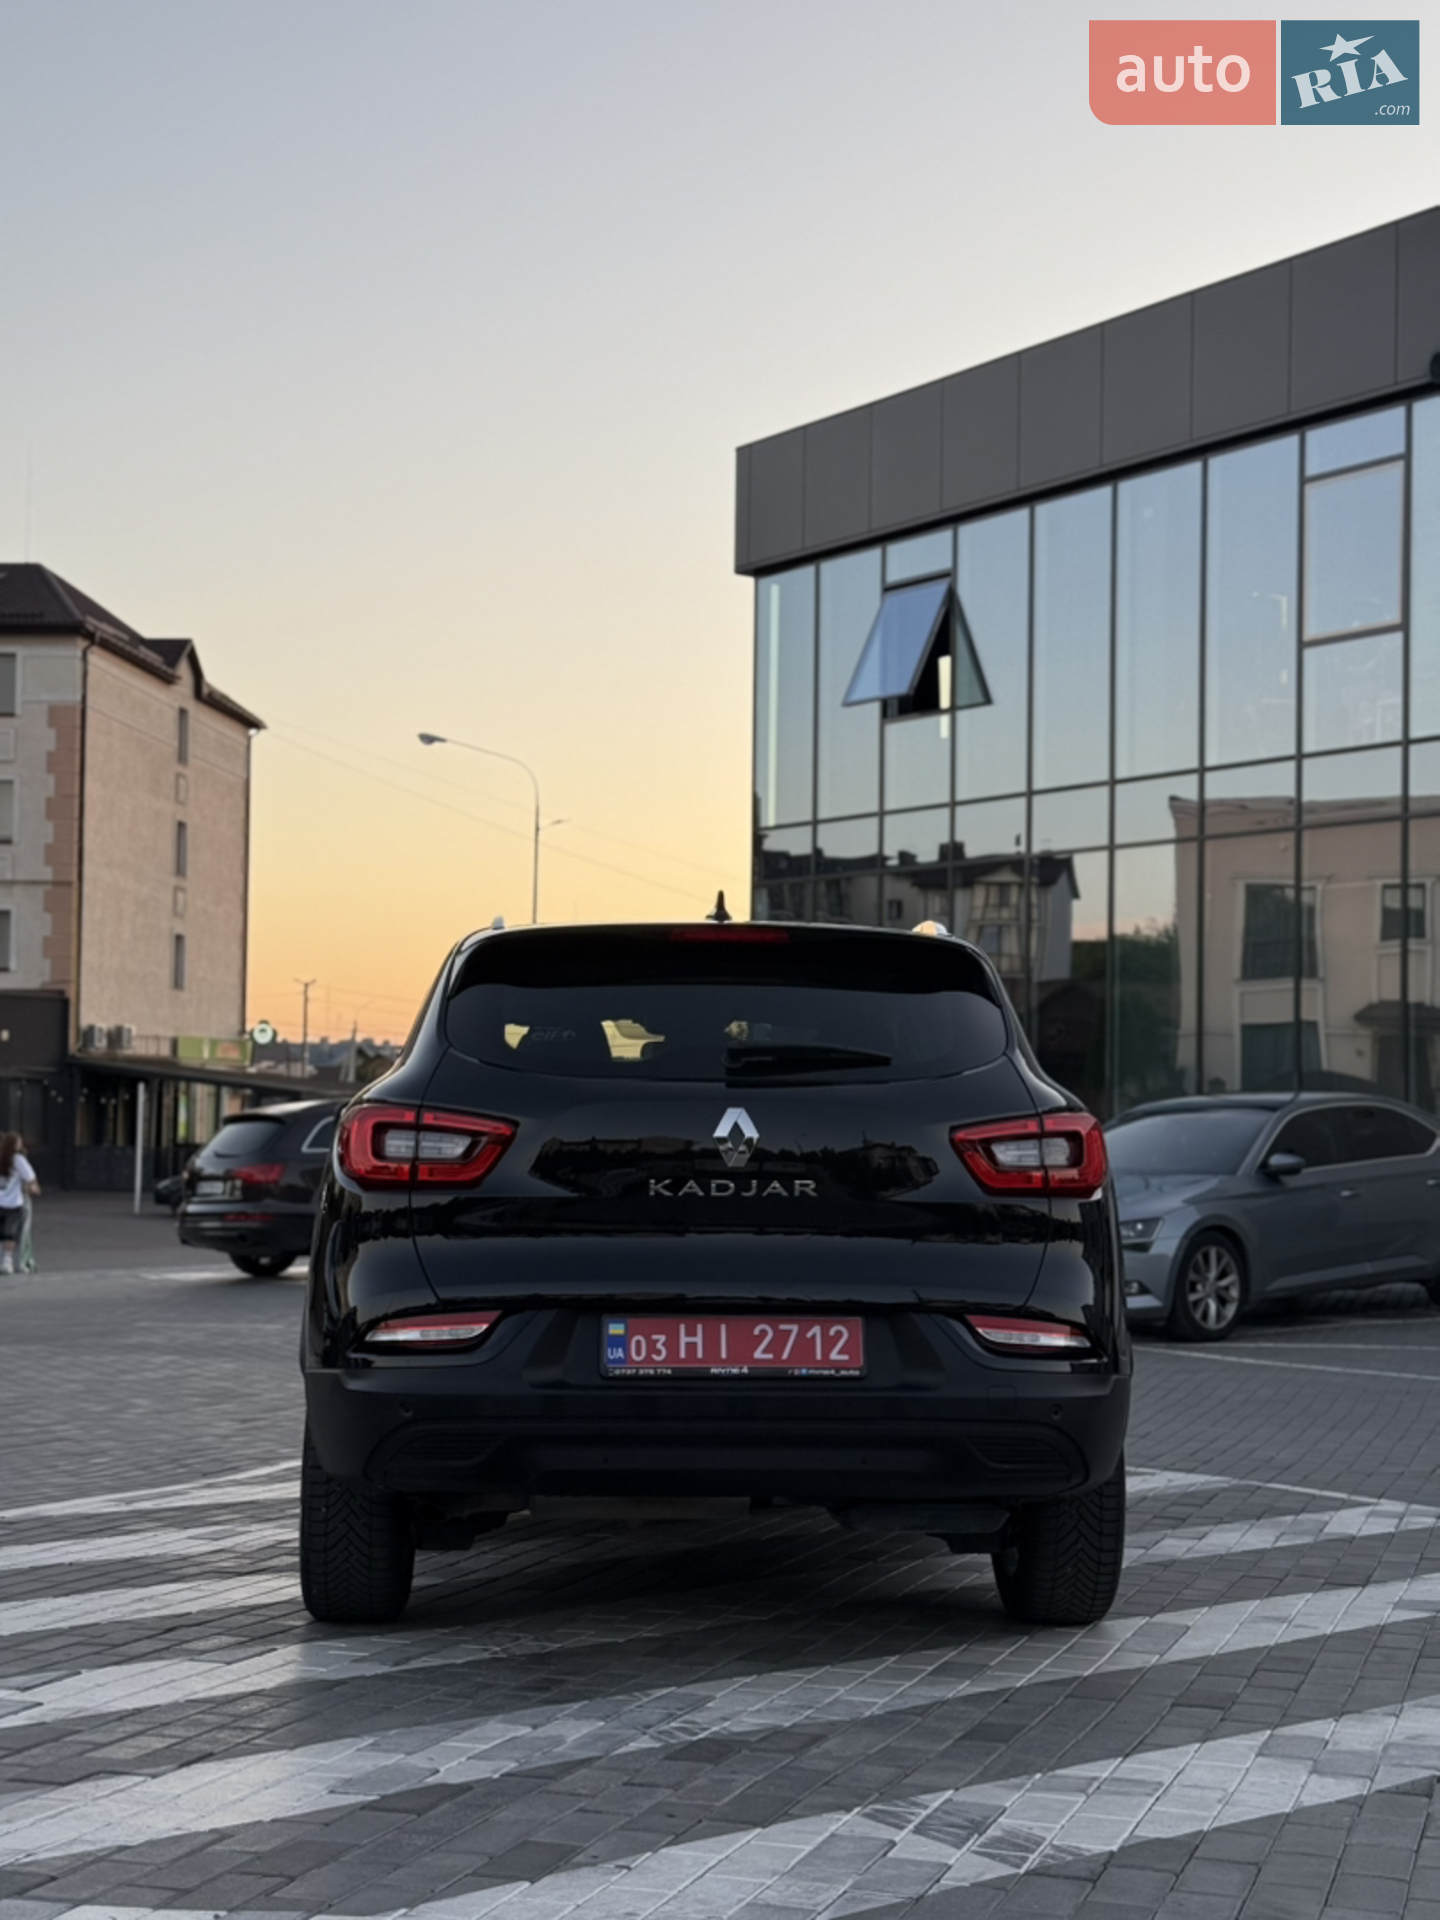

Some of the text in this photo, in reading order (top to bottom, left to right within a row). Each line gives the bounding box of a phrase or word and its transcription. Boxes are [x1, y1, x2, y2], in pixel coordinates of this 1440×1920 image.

[648, 1178, 818, 1197] KADJAR
[630, 1334, 668, 1361] 03
[753, 1324, 849, 1360] 2712
[607, 1347, 625, 1359] UA
